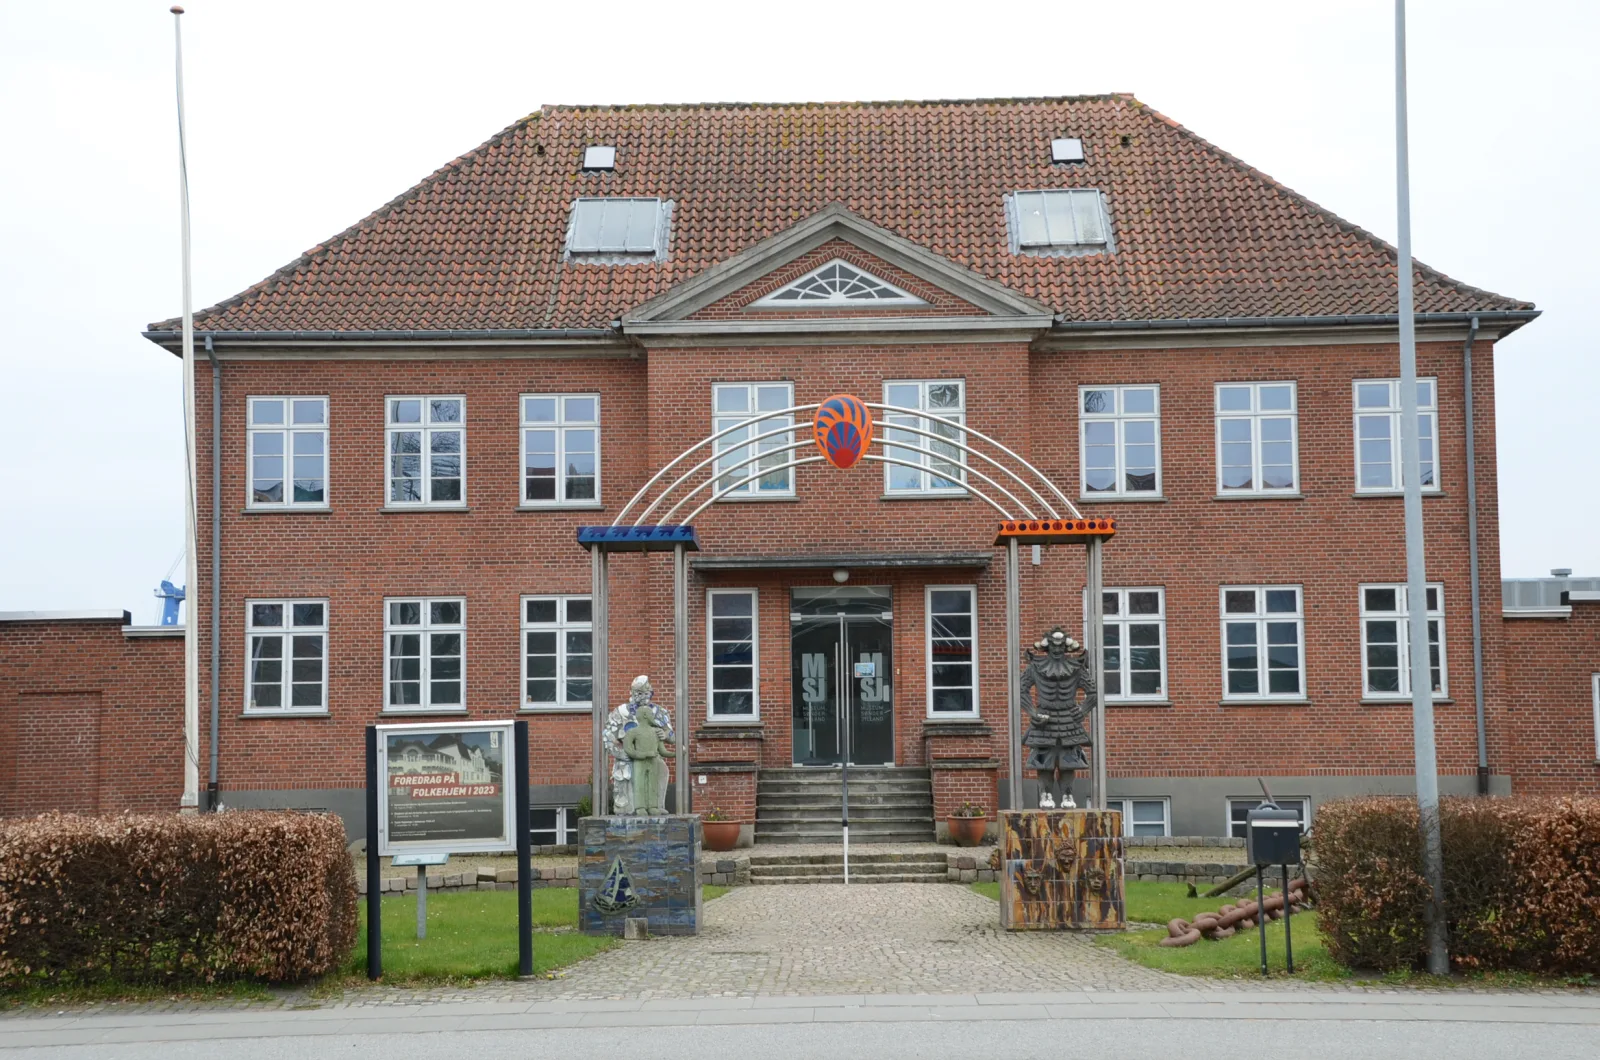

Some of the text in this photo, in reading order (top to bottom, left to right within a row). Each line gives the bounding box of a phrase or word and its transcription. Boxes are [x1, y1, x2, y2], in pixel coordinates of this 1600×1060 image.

[802, 653, 825, 678] M
[394, 772, 456, 785] FOREDRAG PÅ
[412, 785, 495, 797] FOLKEHJEM I 2023
